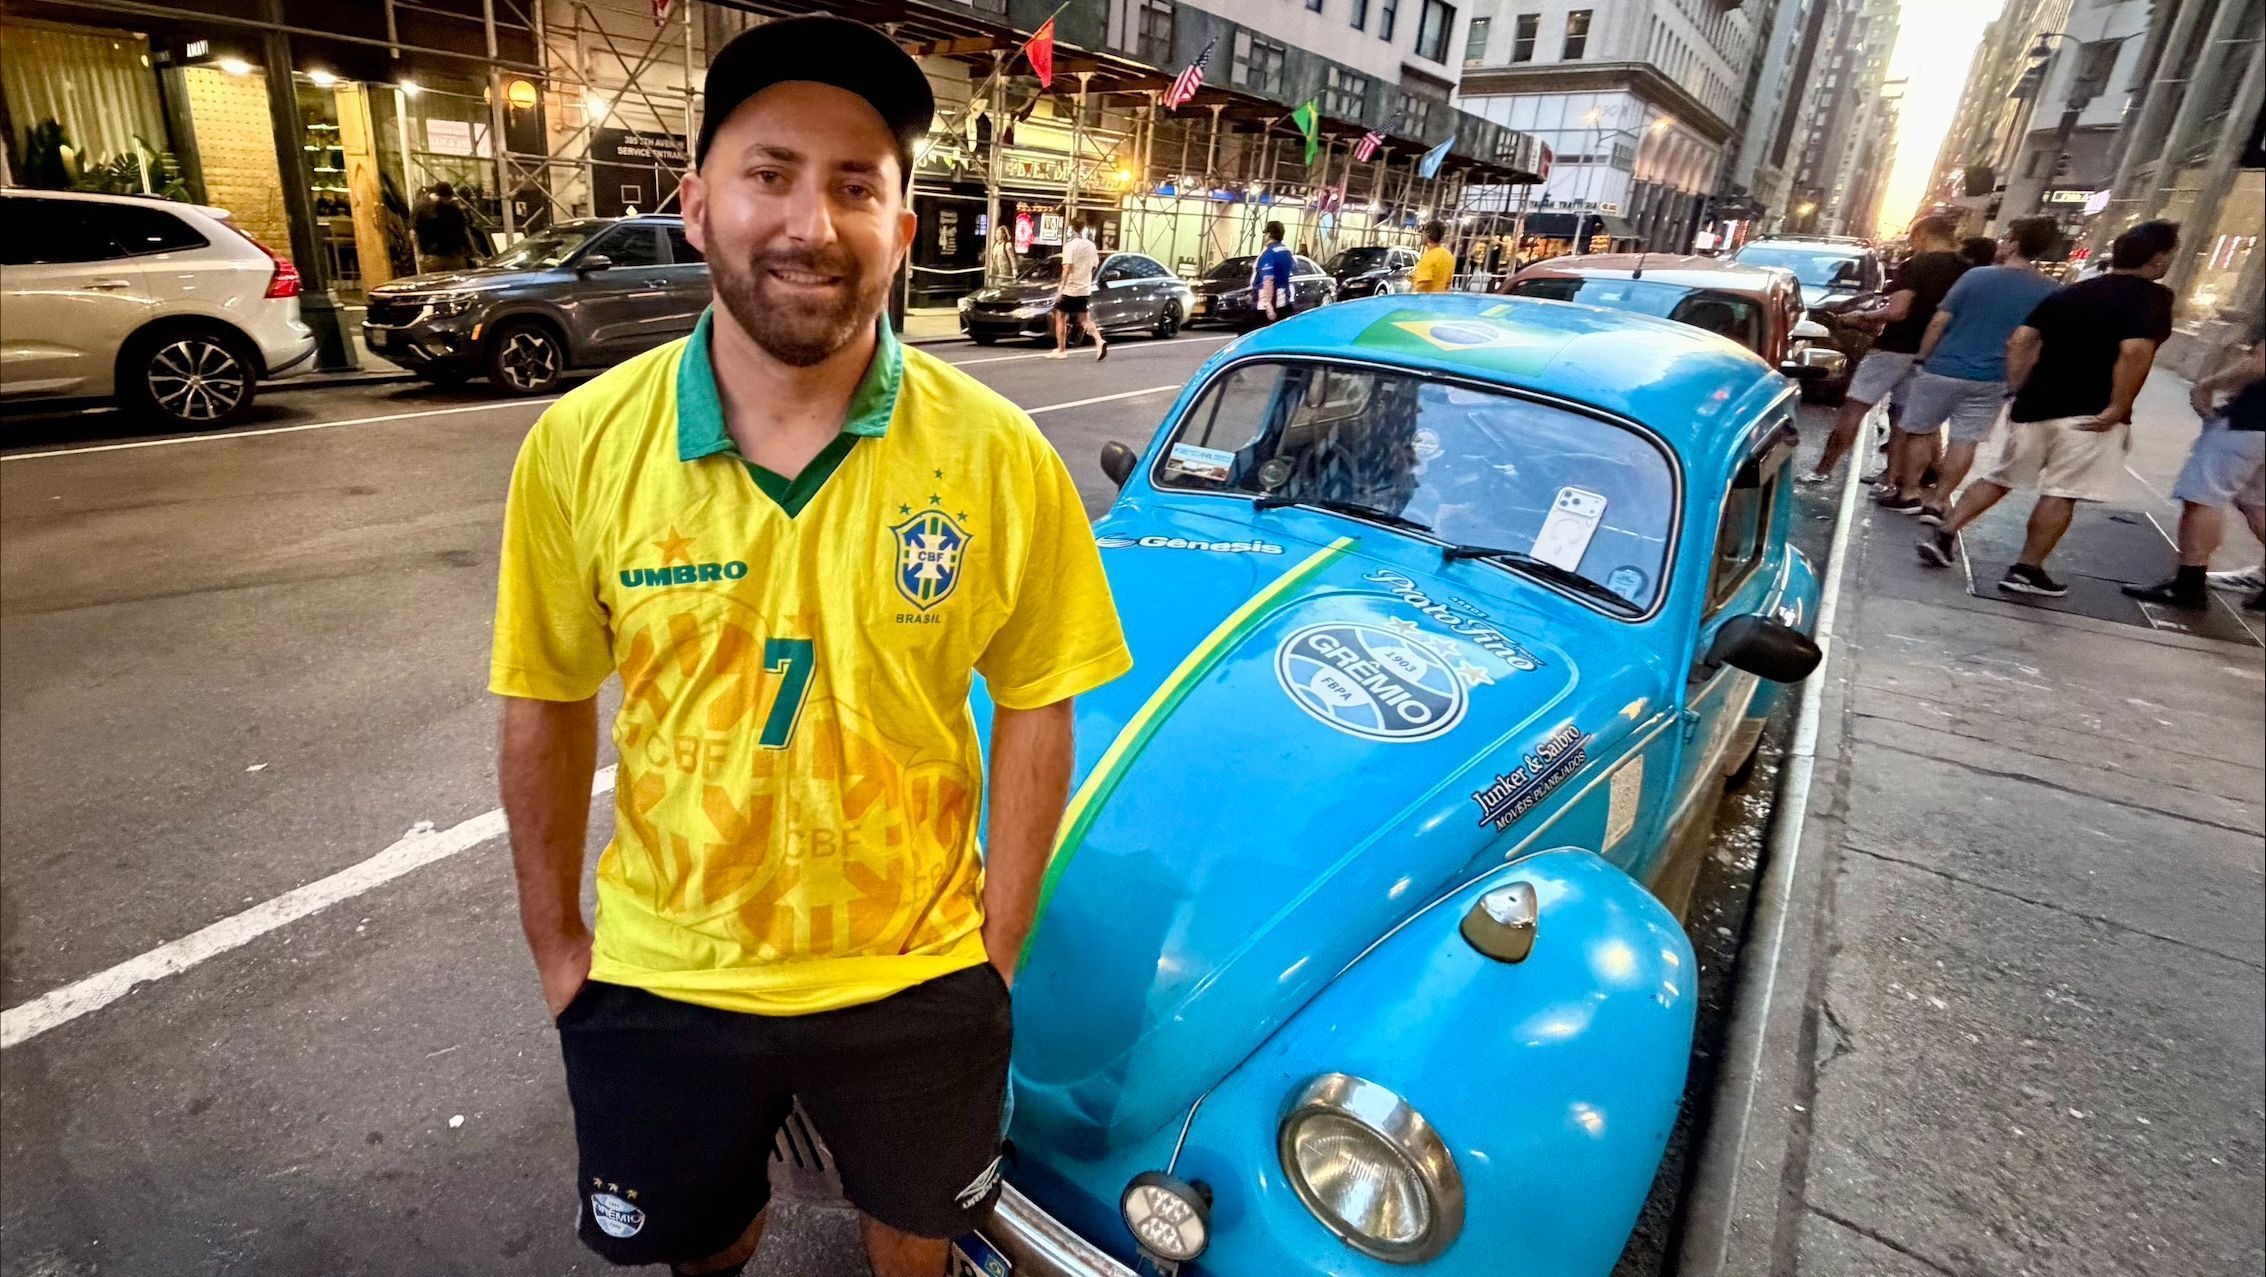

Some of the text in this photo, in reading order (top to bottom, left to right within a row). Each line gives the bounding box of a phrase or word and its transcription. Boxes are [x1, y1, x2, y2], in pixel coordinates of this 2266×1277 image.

[617, 146, 651, 158] SERVICE
[917, 549, 945, 563] CBF
[1139, 535, 1284, 554] Genesis
[618, 560, 749, 588] UMBRO
[895, 613, 942, 625] BRASIL
[1384, 650, 1417, 673] 1903
[1308, 634, 1432, 724] GRÊMIO
[1320, 676, 1353, 701] FBPA
[757, 637, 817, 750] 7
[645, 730, 730, 778] CBF
[1473, 725, 1580, 816] Junker & Saibro
[1533, 750, 1587, 802] PLANEJADOS
[785, 825, 863, 859] CBF
